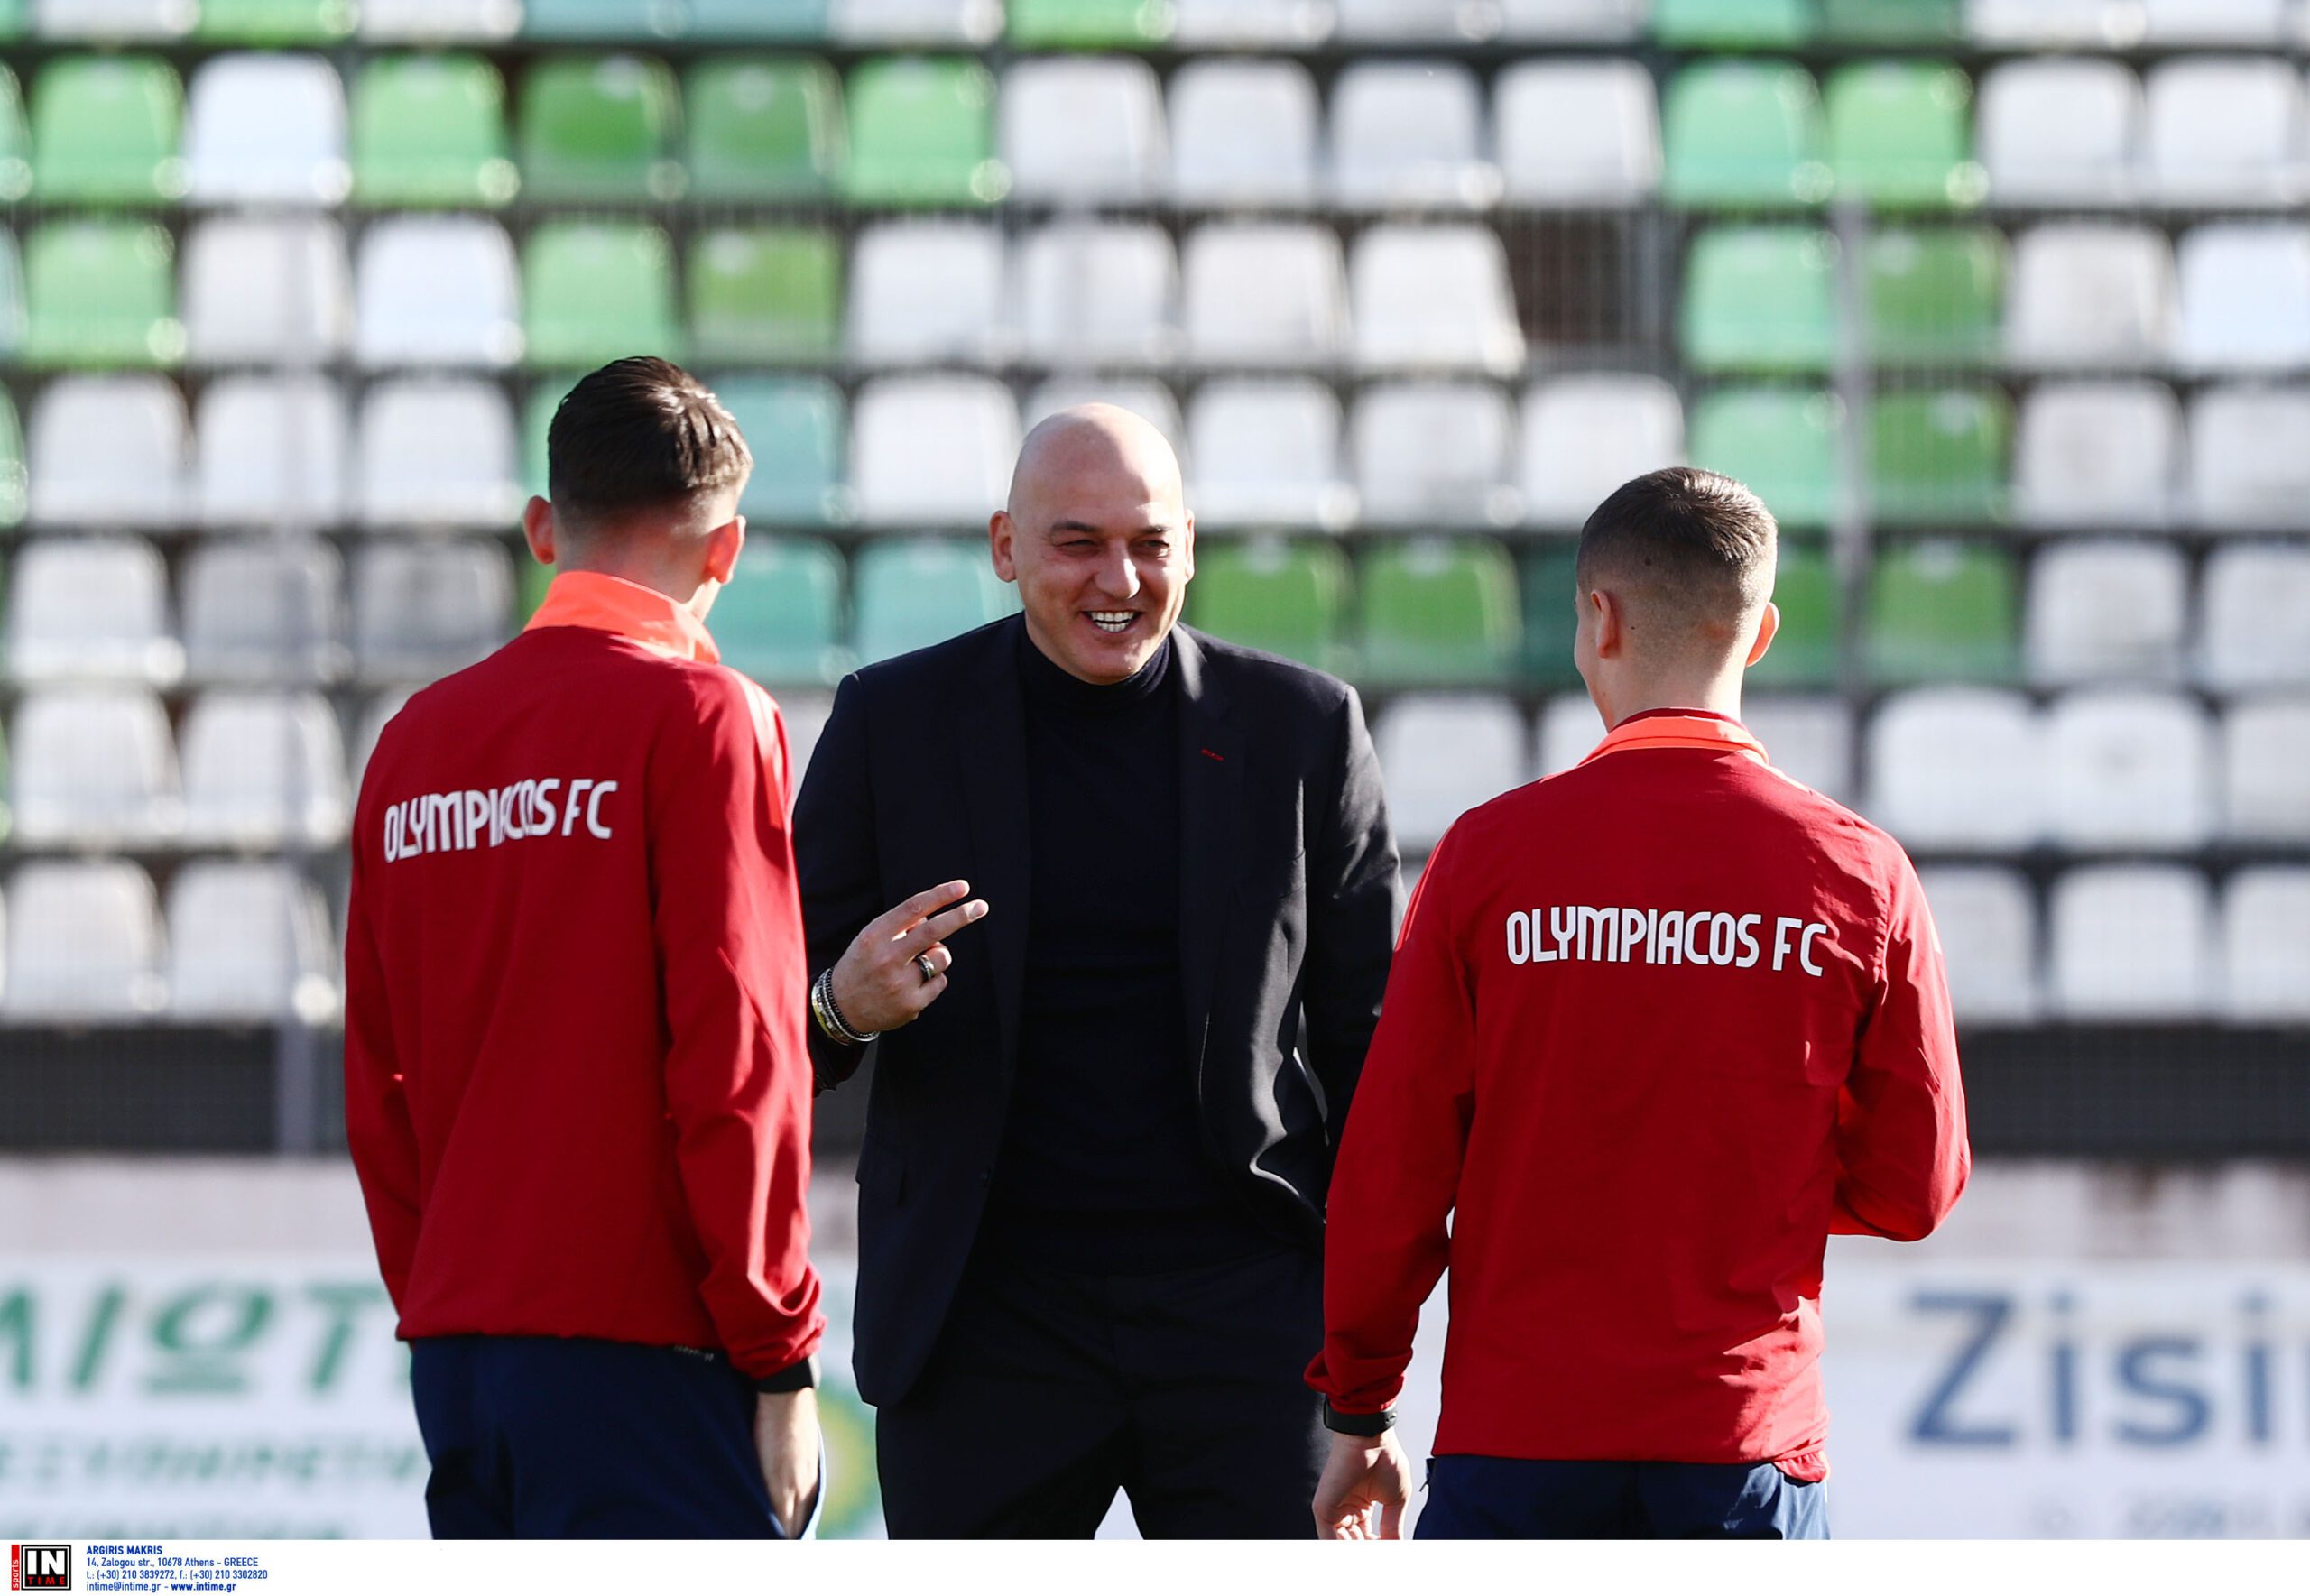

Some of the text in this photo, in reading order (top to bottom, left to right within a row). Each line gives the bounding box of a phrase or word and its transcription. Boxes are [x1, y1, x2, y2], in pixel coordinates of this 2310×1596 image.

[561, 778, 619, 840] FC
[1506, 906, 1828, 977] OLYMPIACOS FC
[1906, 1288, 2310, 1447] Zisi
